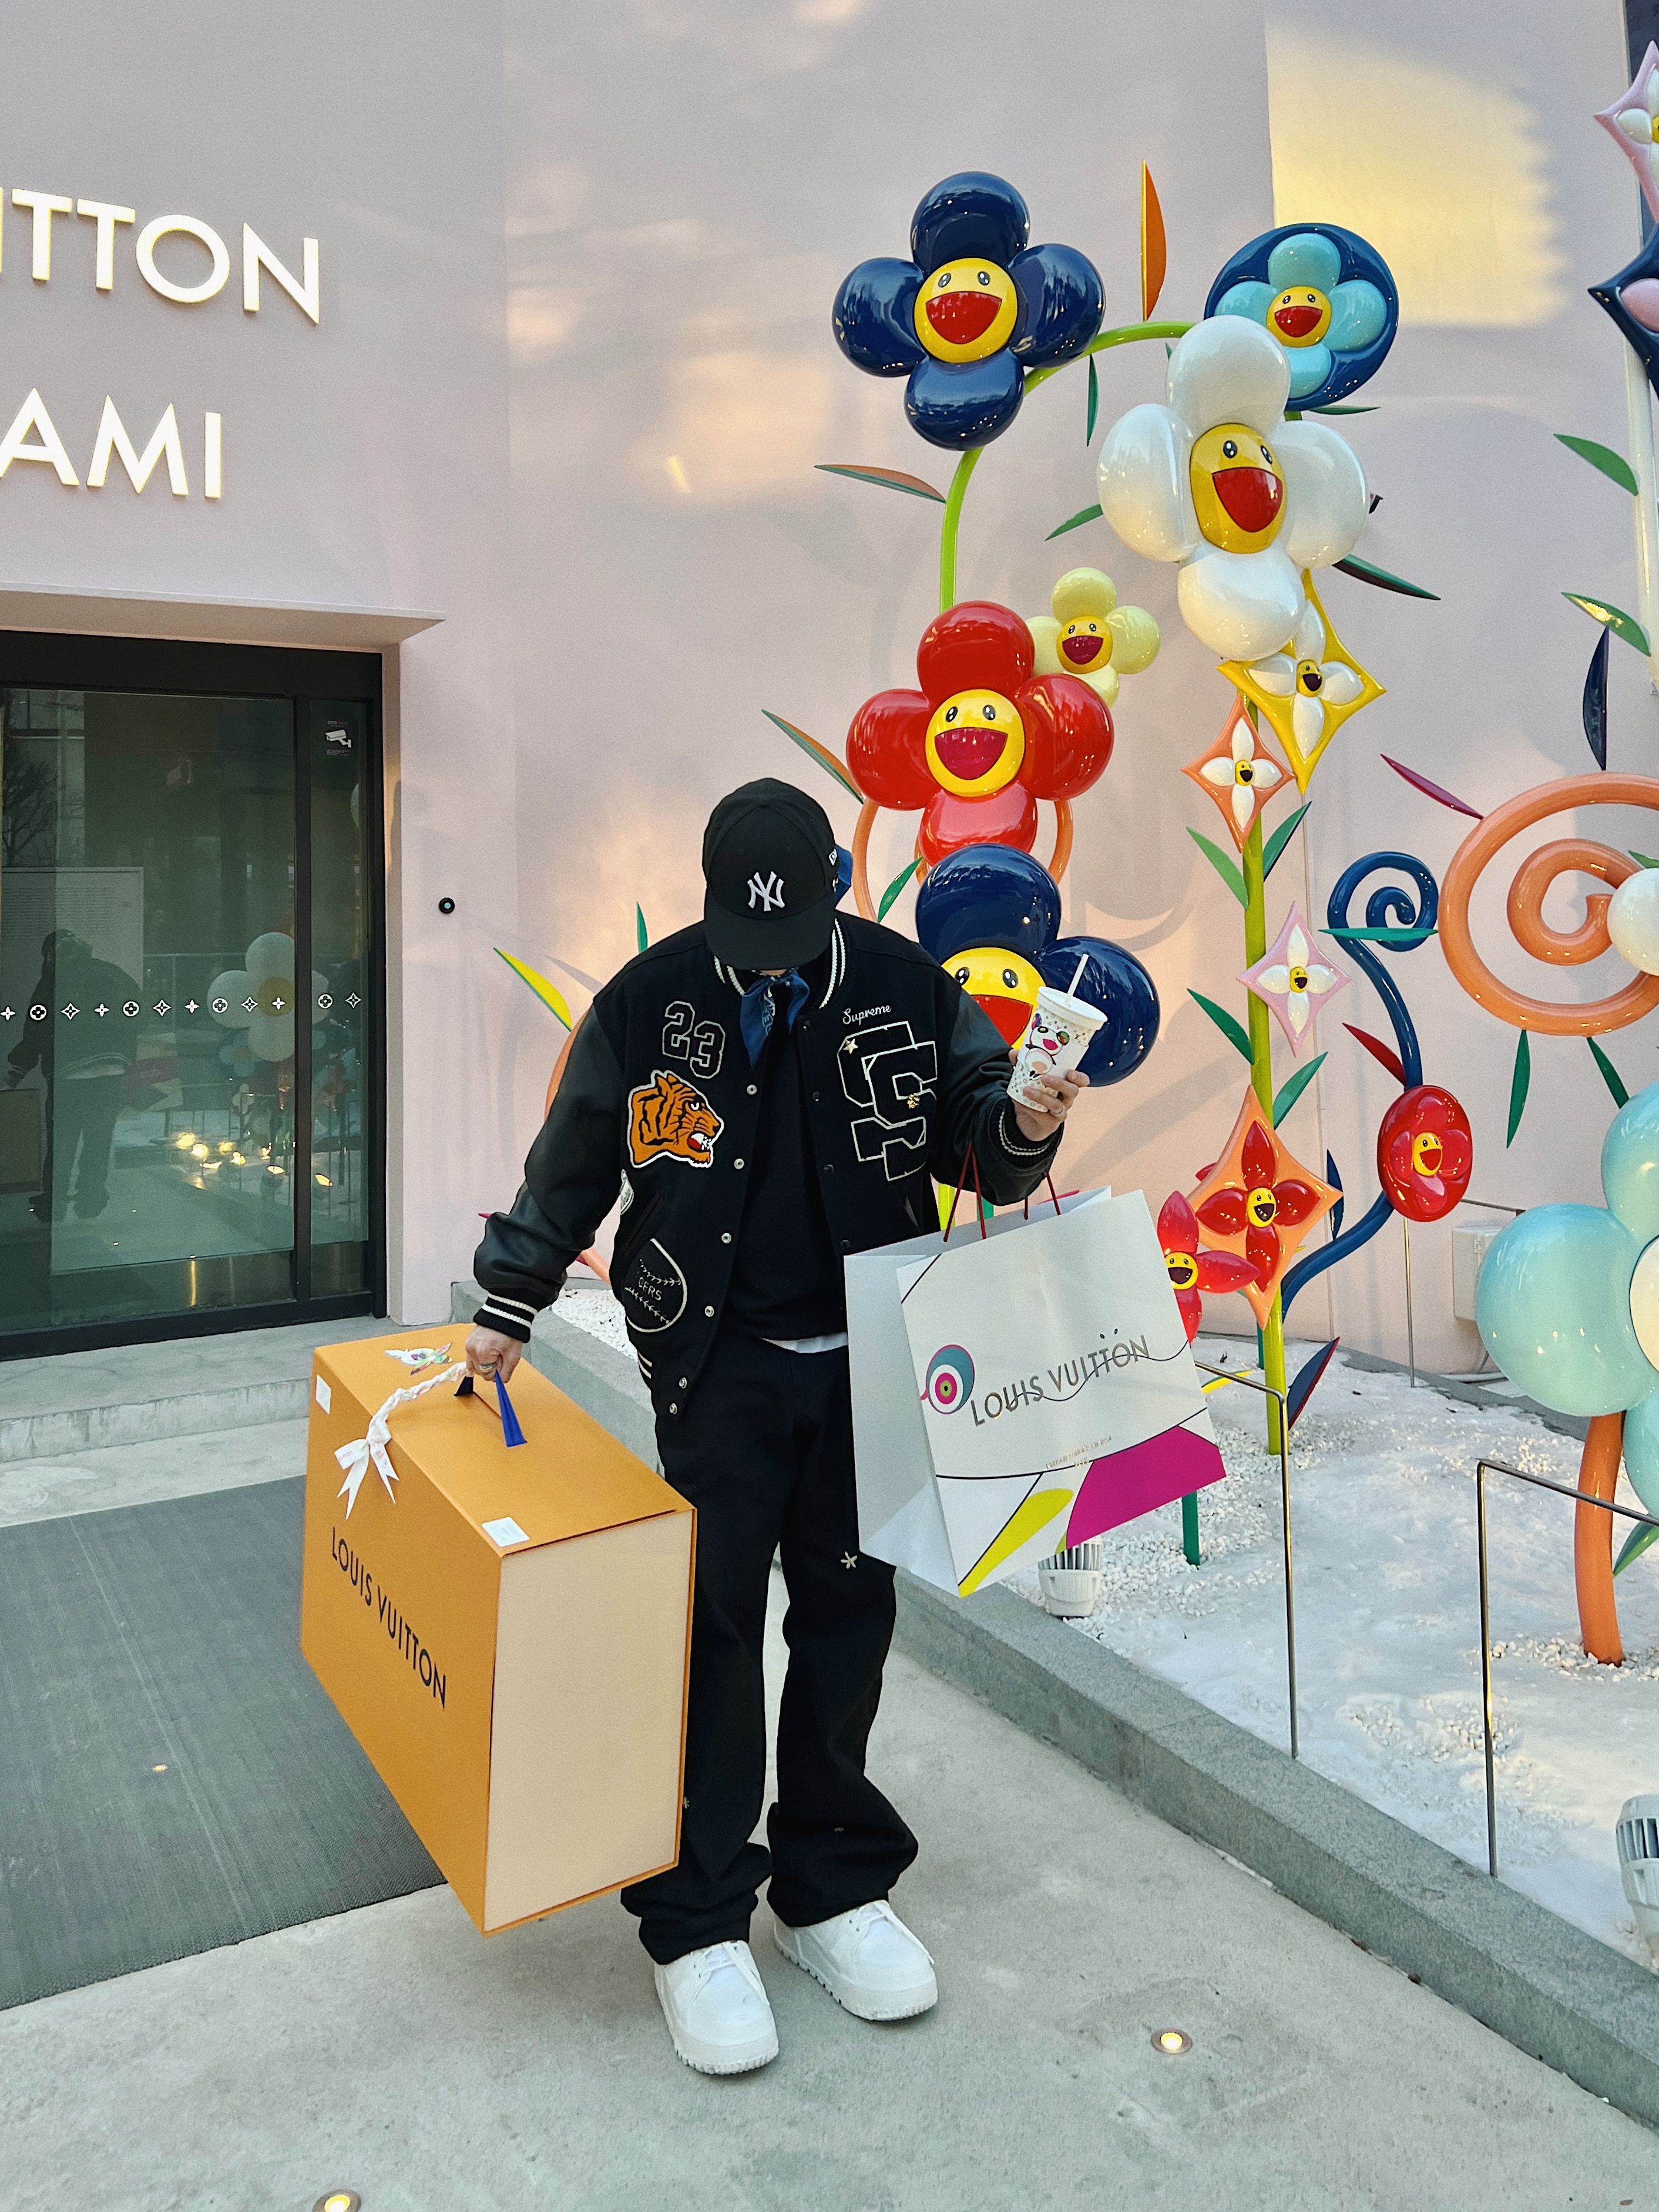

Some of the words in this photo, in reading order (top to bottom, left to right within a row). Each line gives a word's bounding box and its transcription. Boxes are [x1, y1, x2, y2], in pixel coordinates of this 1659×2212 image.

[0, 187, 320, 324] TTON
[0, 387, 221, 498] AMI
[747, 870, 785, 911] NY
[662, 1000, 726, 1079] 23
[842, 1004, 892, 1026] Supreme
[970, 1375, 1043, 1427] LOUIS
[1047, 1334, 1150, 1393] VUITTON
[332, 1527, 372, 1606] LOUIS
[377, 1586, 446, 1710] VUITTON
